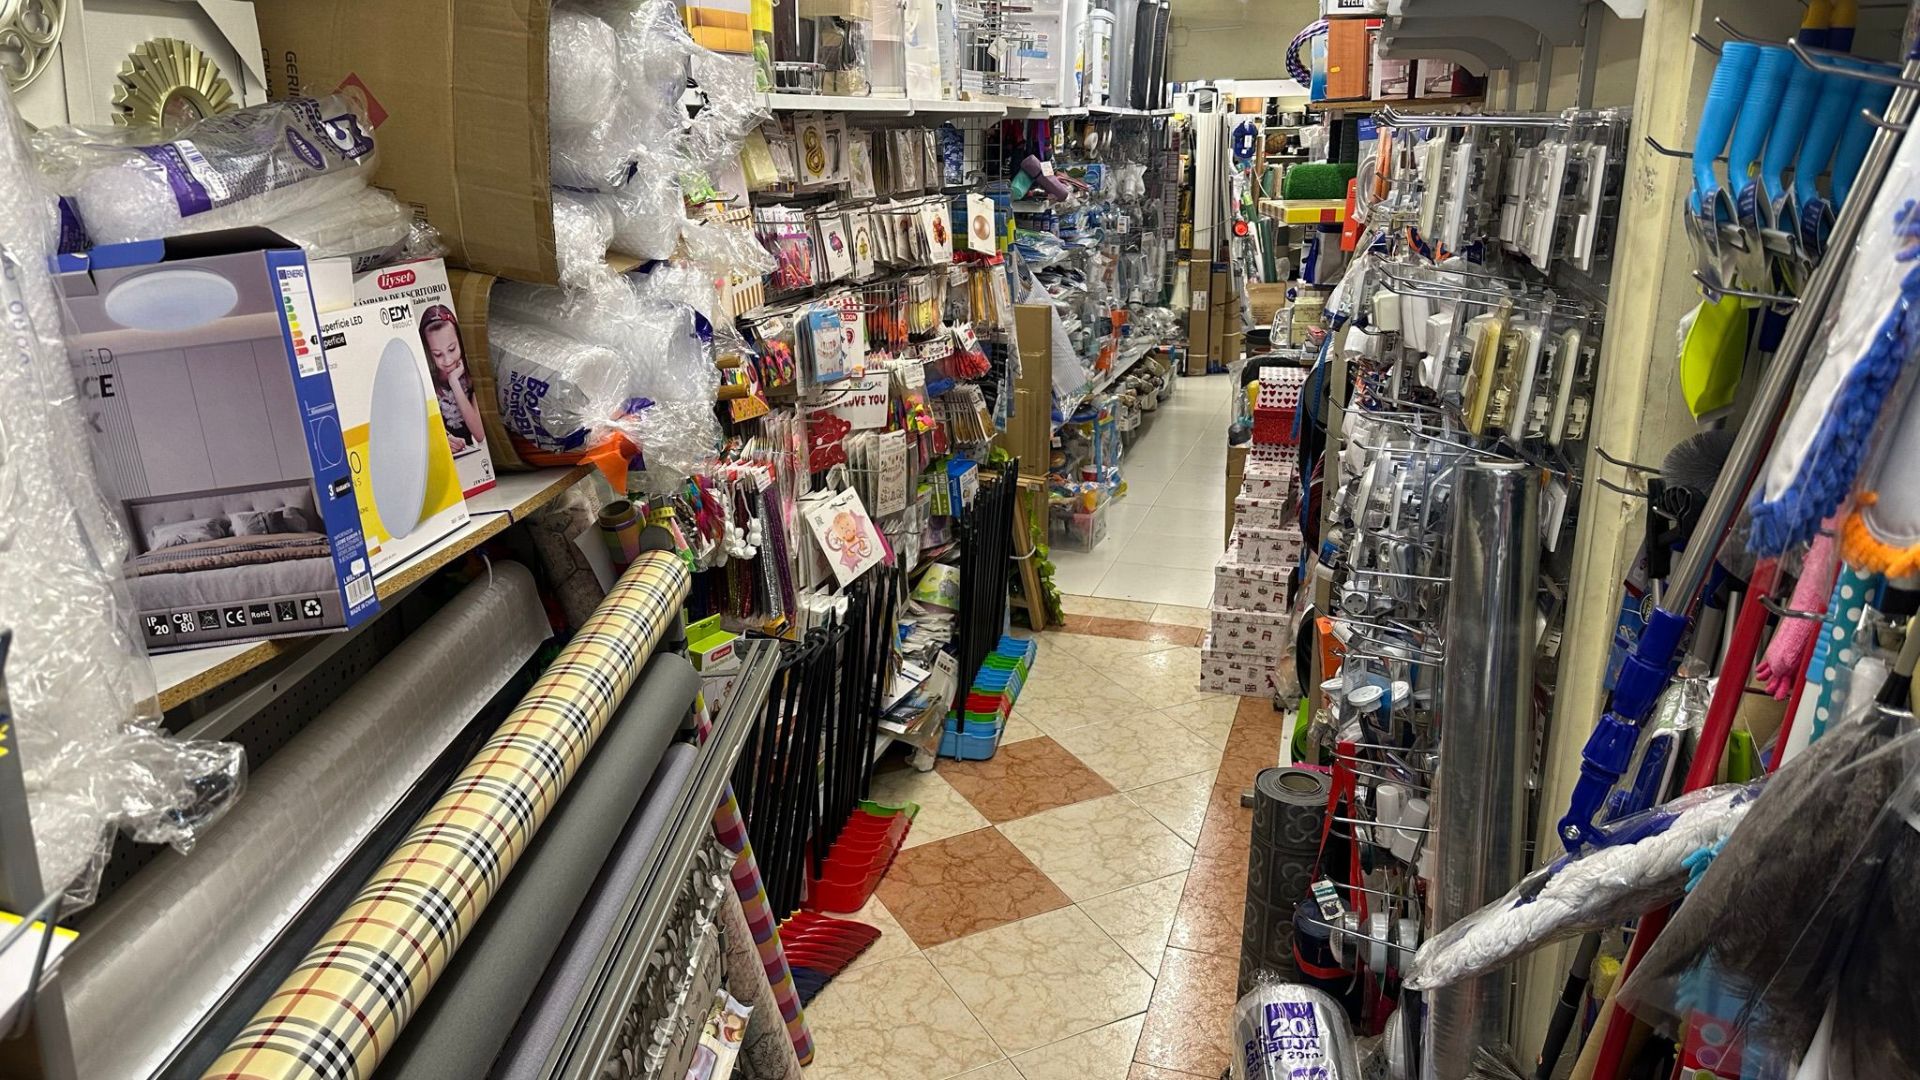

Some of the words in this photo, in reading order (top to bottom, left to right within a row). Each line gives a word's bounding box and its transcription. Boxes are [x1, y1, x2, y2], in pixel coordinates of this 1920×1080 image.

[380, 272, 411, 288] liyset
[388, 304, 412, 323] EDM
[350, 315, 363, 327] LED
[868, 394, 886, 405] YOU
[328, 483, 335, 496] 3
[172, 613, 193, 624] CRI
[251, 609, 271, 619] RoHS
[147, 617, 157, 627] IP
[180, 622, 195, 633] 80
[154, 624, 169, 635] 20
[1271, 1017, 1310, 1038] 20
